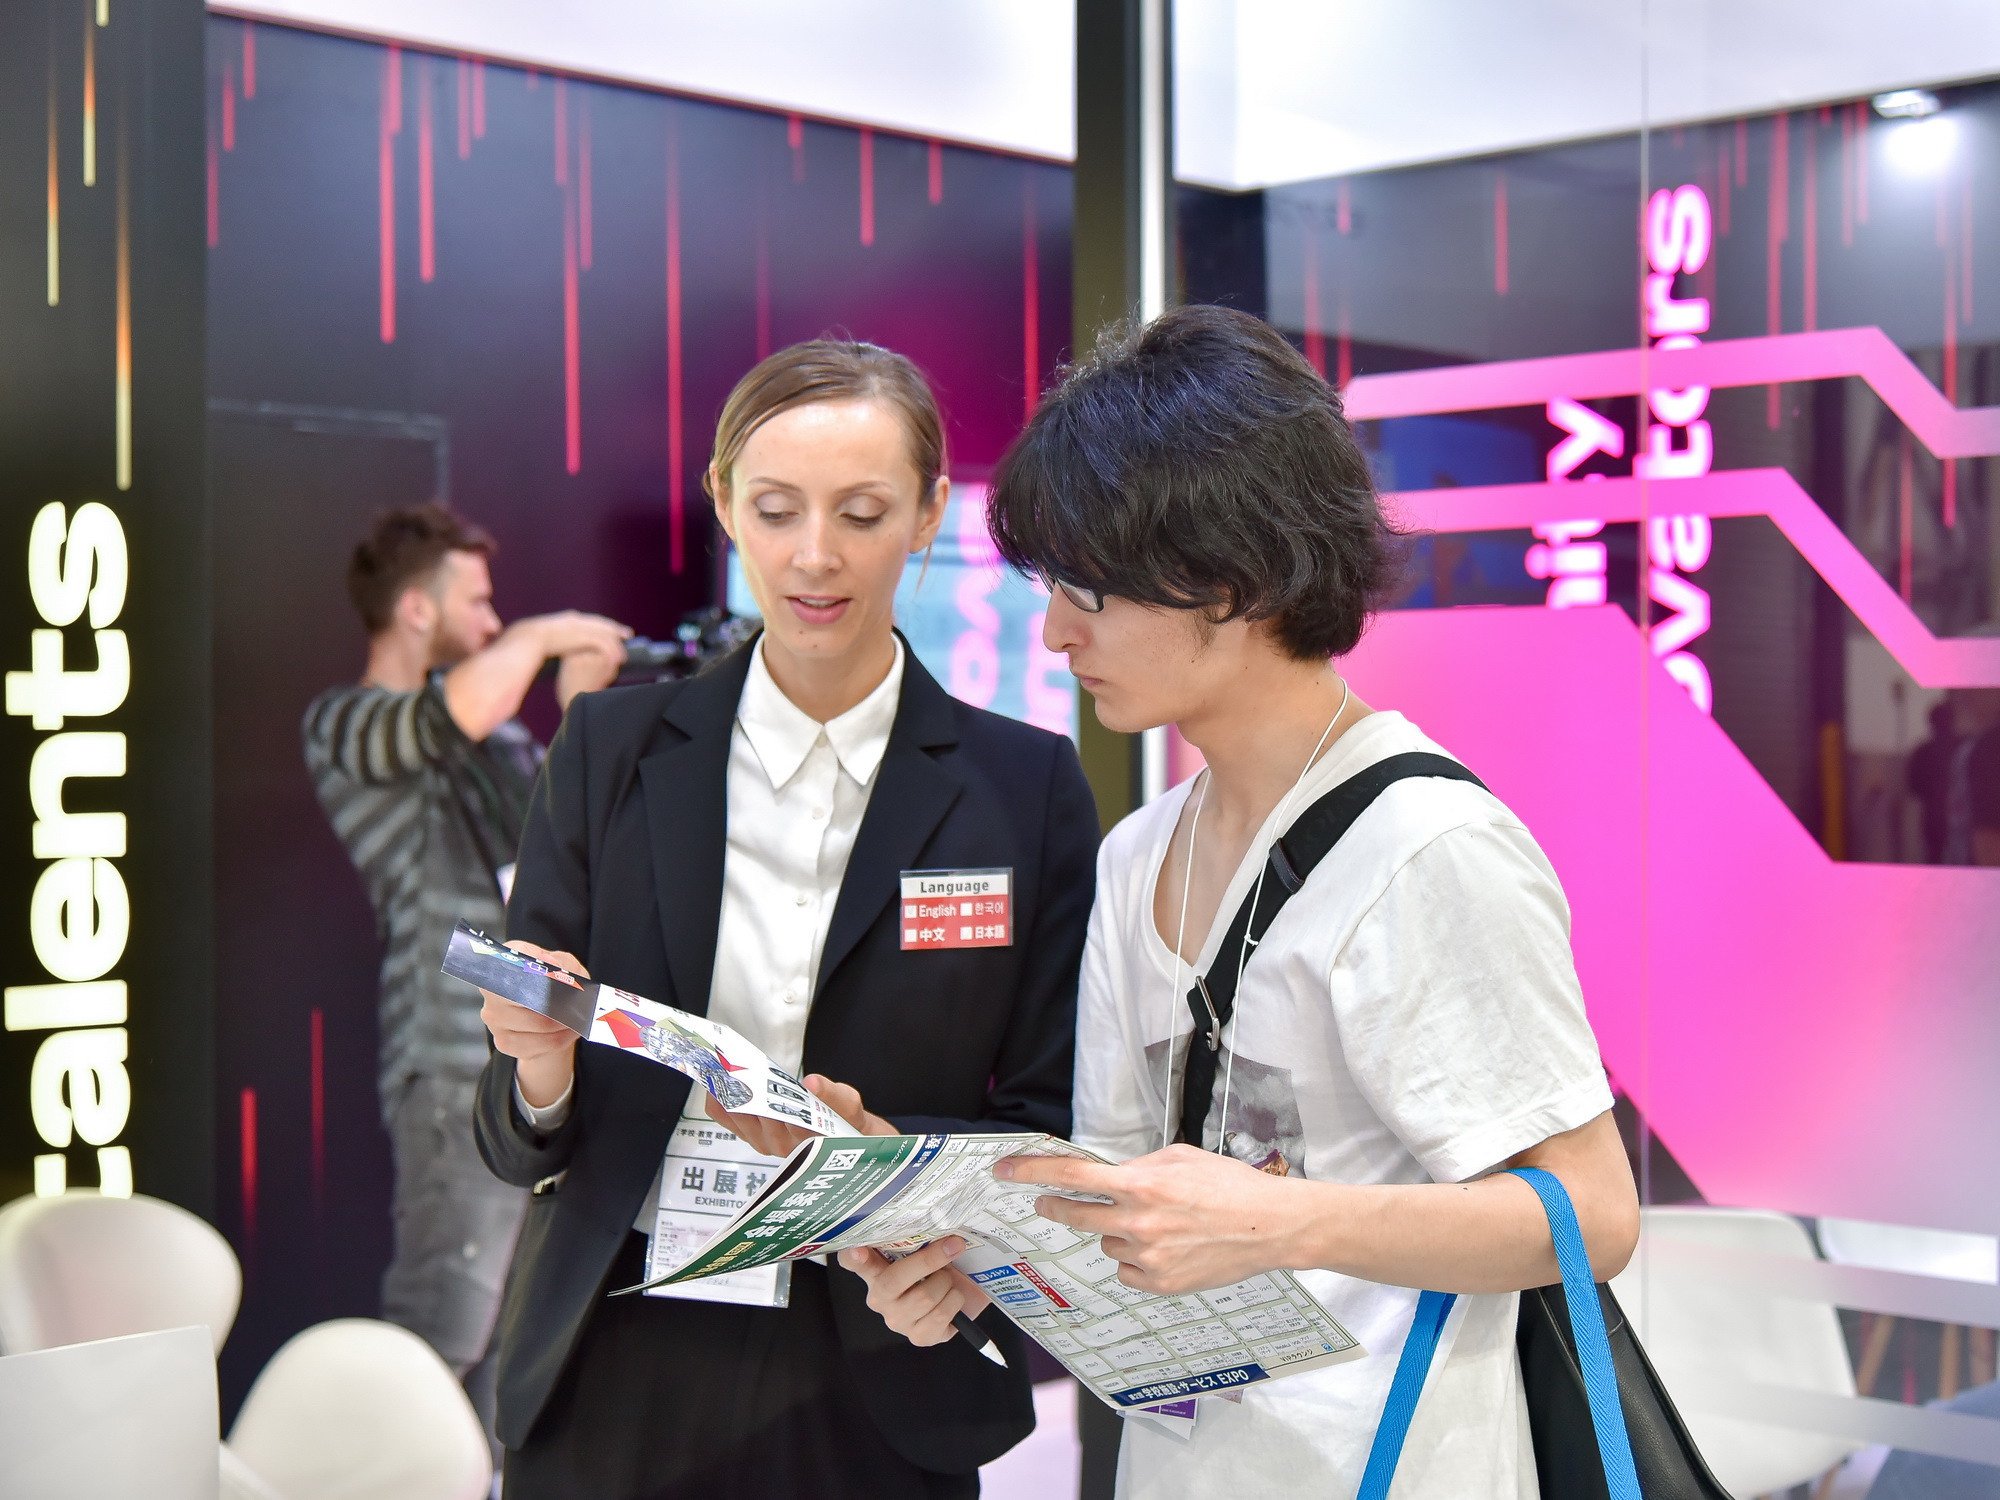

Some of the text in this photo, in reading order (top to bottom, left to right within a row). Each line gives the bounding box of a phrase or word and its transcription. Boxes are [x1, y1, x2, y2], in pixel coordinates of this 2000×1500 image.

[920, 881, 989, 894] Language
[919, 904, 957, 918] English
[974, 902, 1004, 916] 한국어
[919, 928, 946, 942] 中文
[975, 925, 1004, 939] 日本語
[743, 1148, 866, 1240] 会場案内図
[1141, 1375, 1217, 1399] 学校施設・サービス
[1217, 1369, 1249, 1385] EXPO
